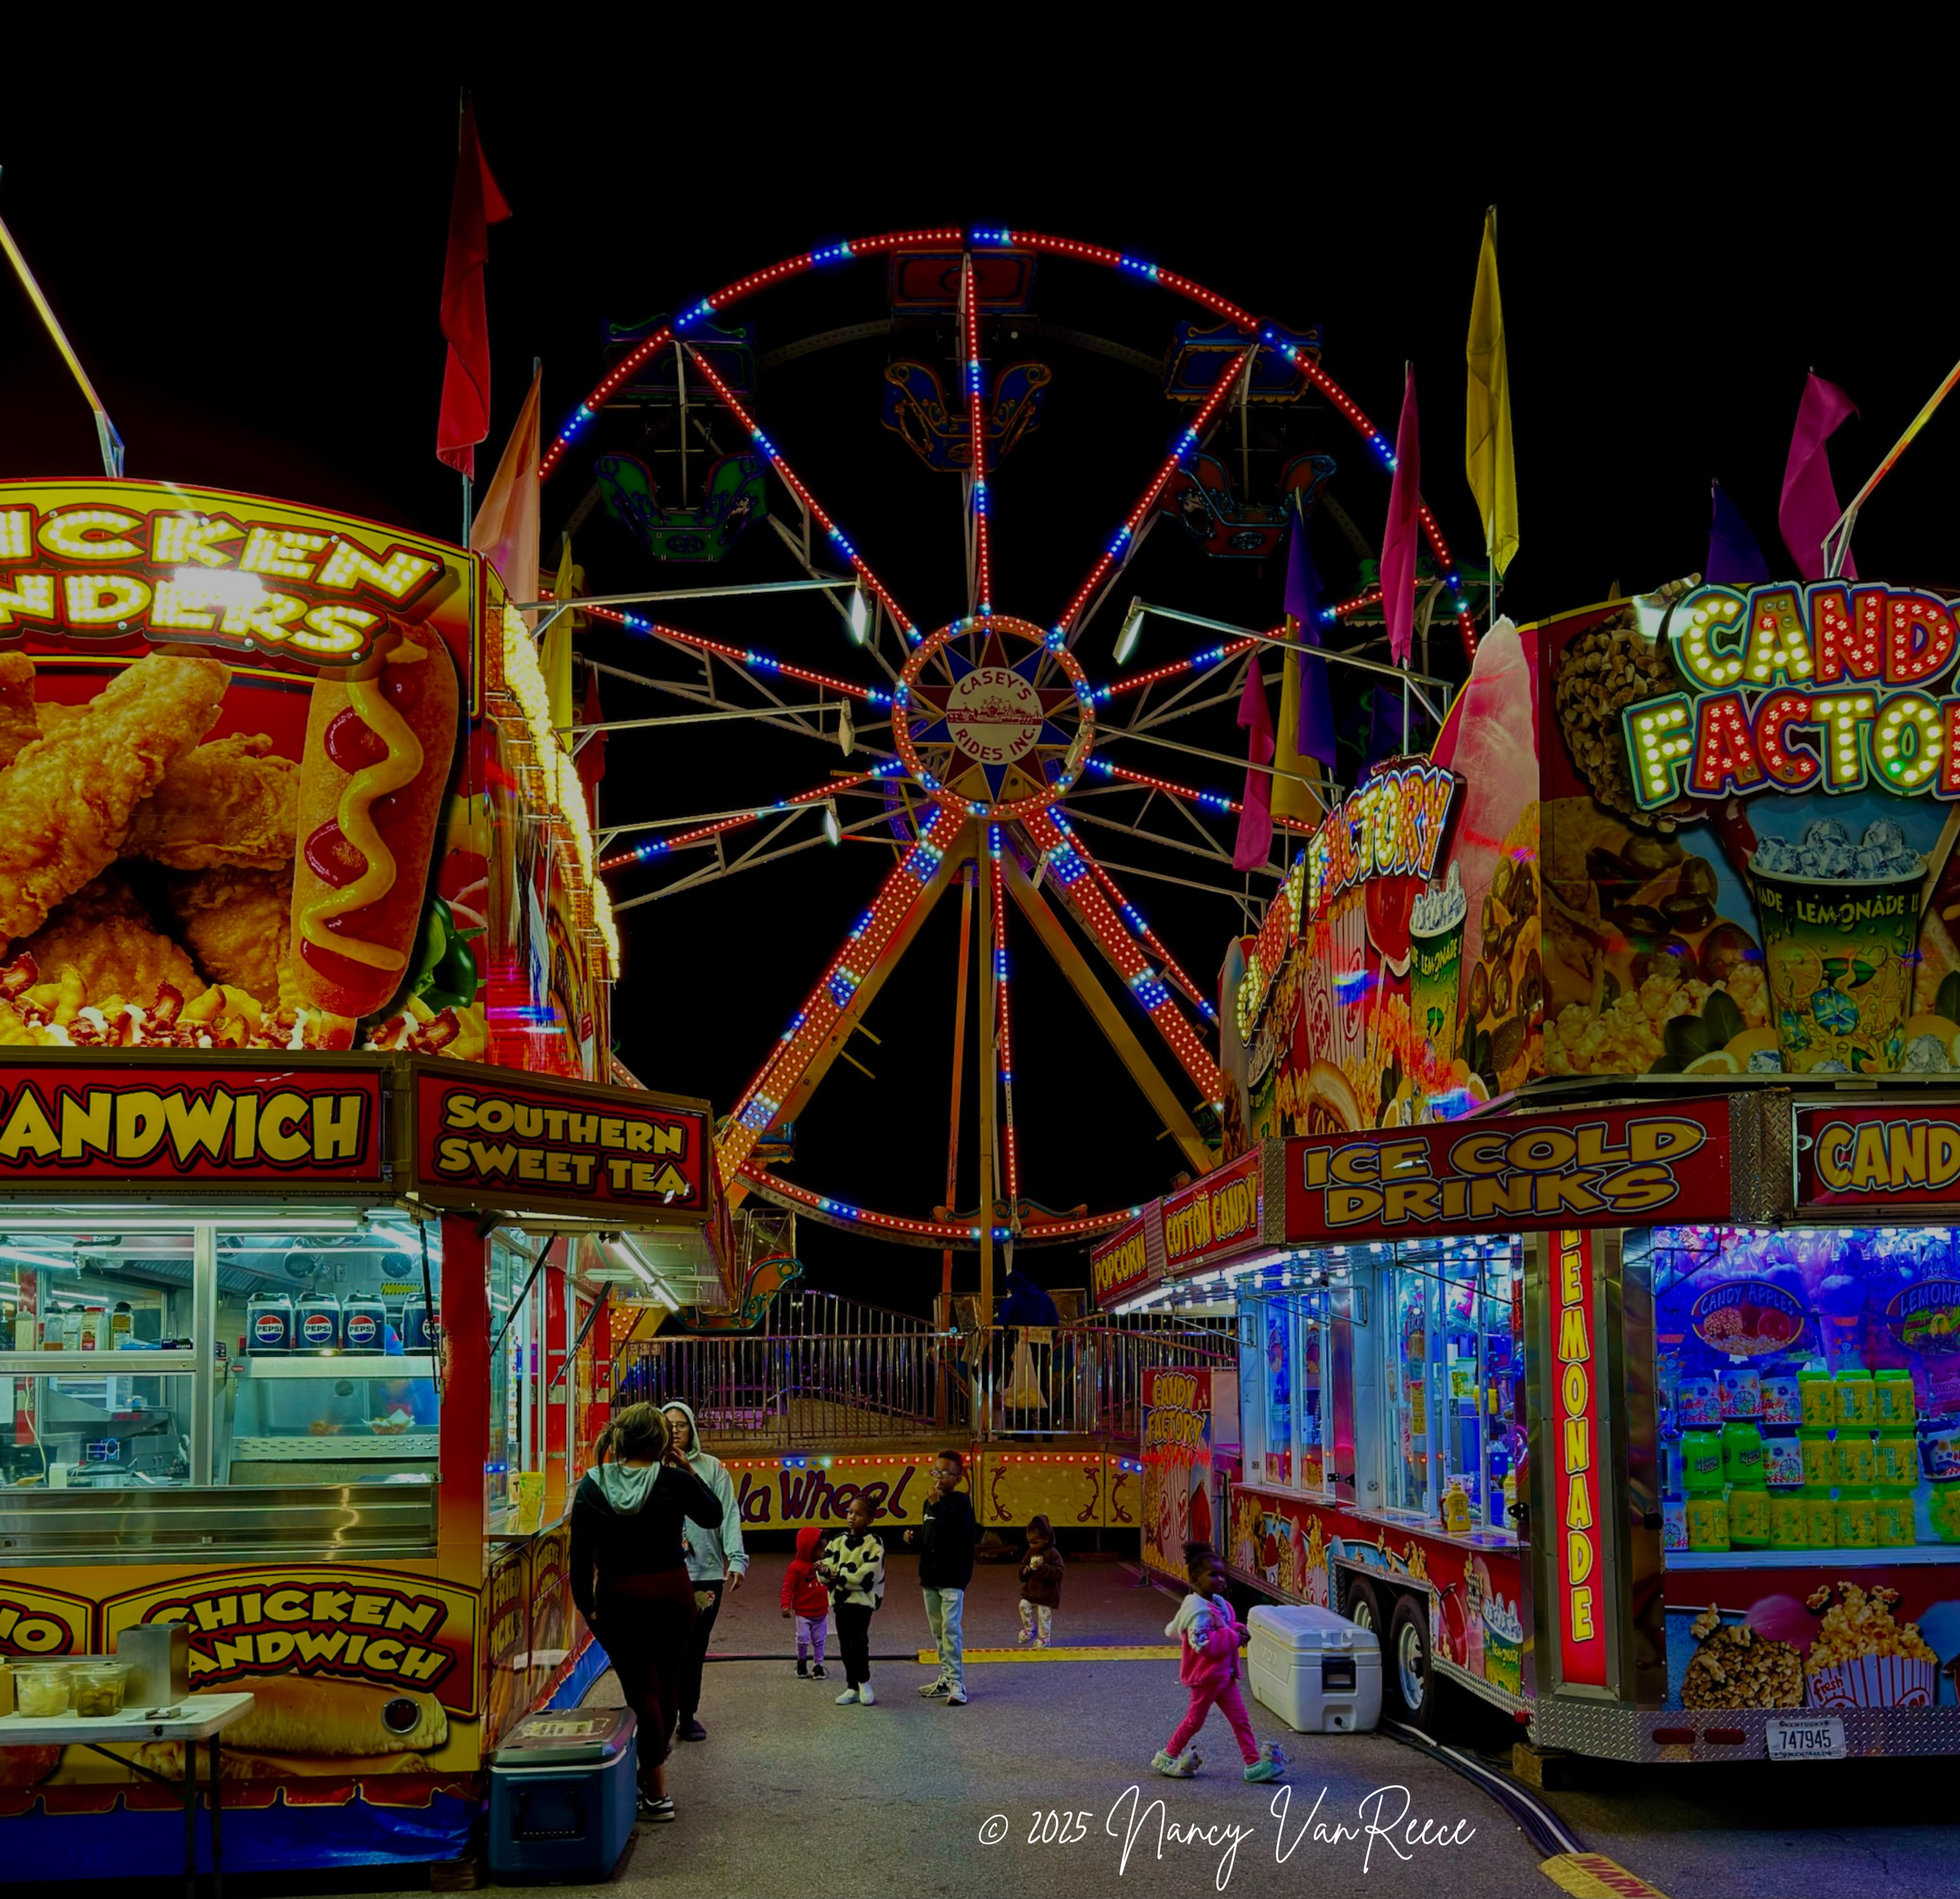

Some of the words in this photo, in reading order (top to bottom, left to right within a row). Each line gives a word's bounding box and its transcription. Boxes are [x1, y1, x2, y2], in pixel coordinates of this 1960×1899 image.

[1673, 586, 1960, 688] CAND
[960, 671, 1032, 700] CASEY'S
[955, 728, 1003, 761] RIDES
[1009, 728, 1036, 756] INC.
[1797, 895, 1904, 925] LEMONADE
[446, 1095, 682, 1154] SOUTHERN
[438, 1138, 595, 1185] SWEET
[608, 1159, 688, 1196] TEA
[1305, 1138, 1430, 1187] ICE
[1451, 1120, 1704, 1175] COLD
[1166, 1199, 1211, 1258] COTTON
[1212, 1171, 1258, 1240] CANDY
[1327, 1166, 1678, 1225] DRINKS
[1094, 1231, 1147, 1296] POPCORN
[1700, 1287, 1743, 1315] CANDY
[1748, 1284, 1794, 1316] APPLES
[1153, 1373, 1197, 1409] CANDY
[1147, 1409, 1203, 1451] FACTORY
[779, 1466, 915, 1521] Wheel
[151, 1590, 438, 1633] CHICKEN
[493, 1565, 521, 1615] FRIED
[189, 1628, 447, 1679] ANDWICH
[1813, 1676, 1843, 1702] fresh
[1779, 1729, 1831, 1749] 747945
